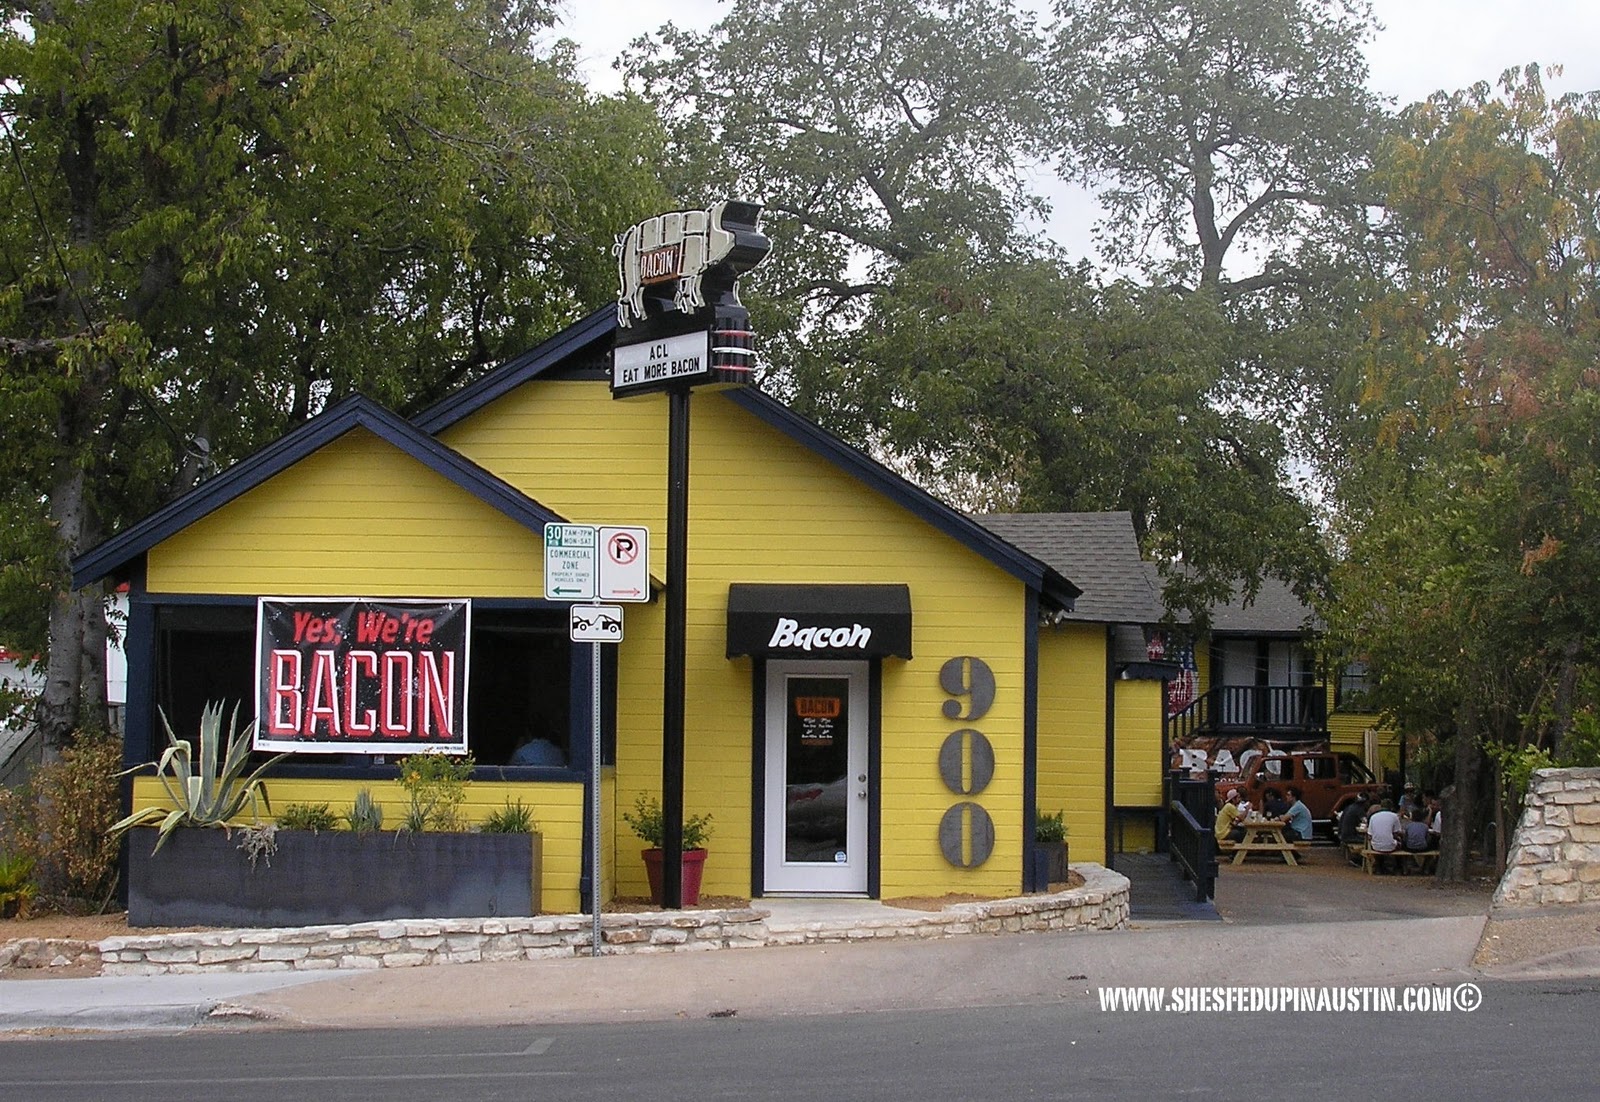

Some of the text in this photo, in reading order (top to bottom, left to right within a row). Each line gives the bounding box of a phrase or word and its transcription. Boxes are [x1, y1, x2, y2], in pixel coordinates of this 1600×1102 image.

[641, 250, 674, 279] BACON
[649, 343, 669, 360] ACL
[623, 356, 700, 383] EAT MORE BACON
[547, 526, 562, 540] 30
[550, 549, 591, 559] COMMERCIAL
[562, 561, 579, 570] ZONE
[292, 611, 435, 646] Yes, We're
[768, 617, 872, 651] Bacon
[268, 649, 455, 738] BACON
